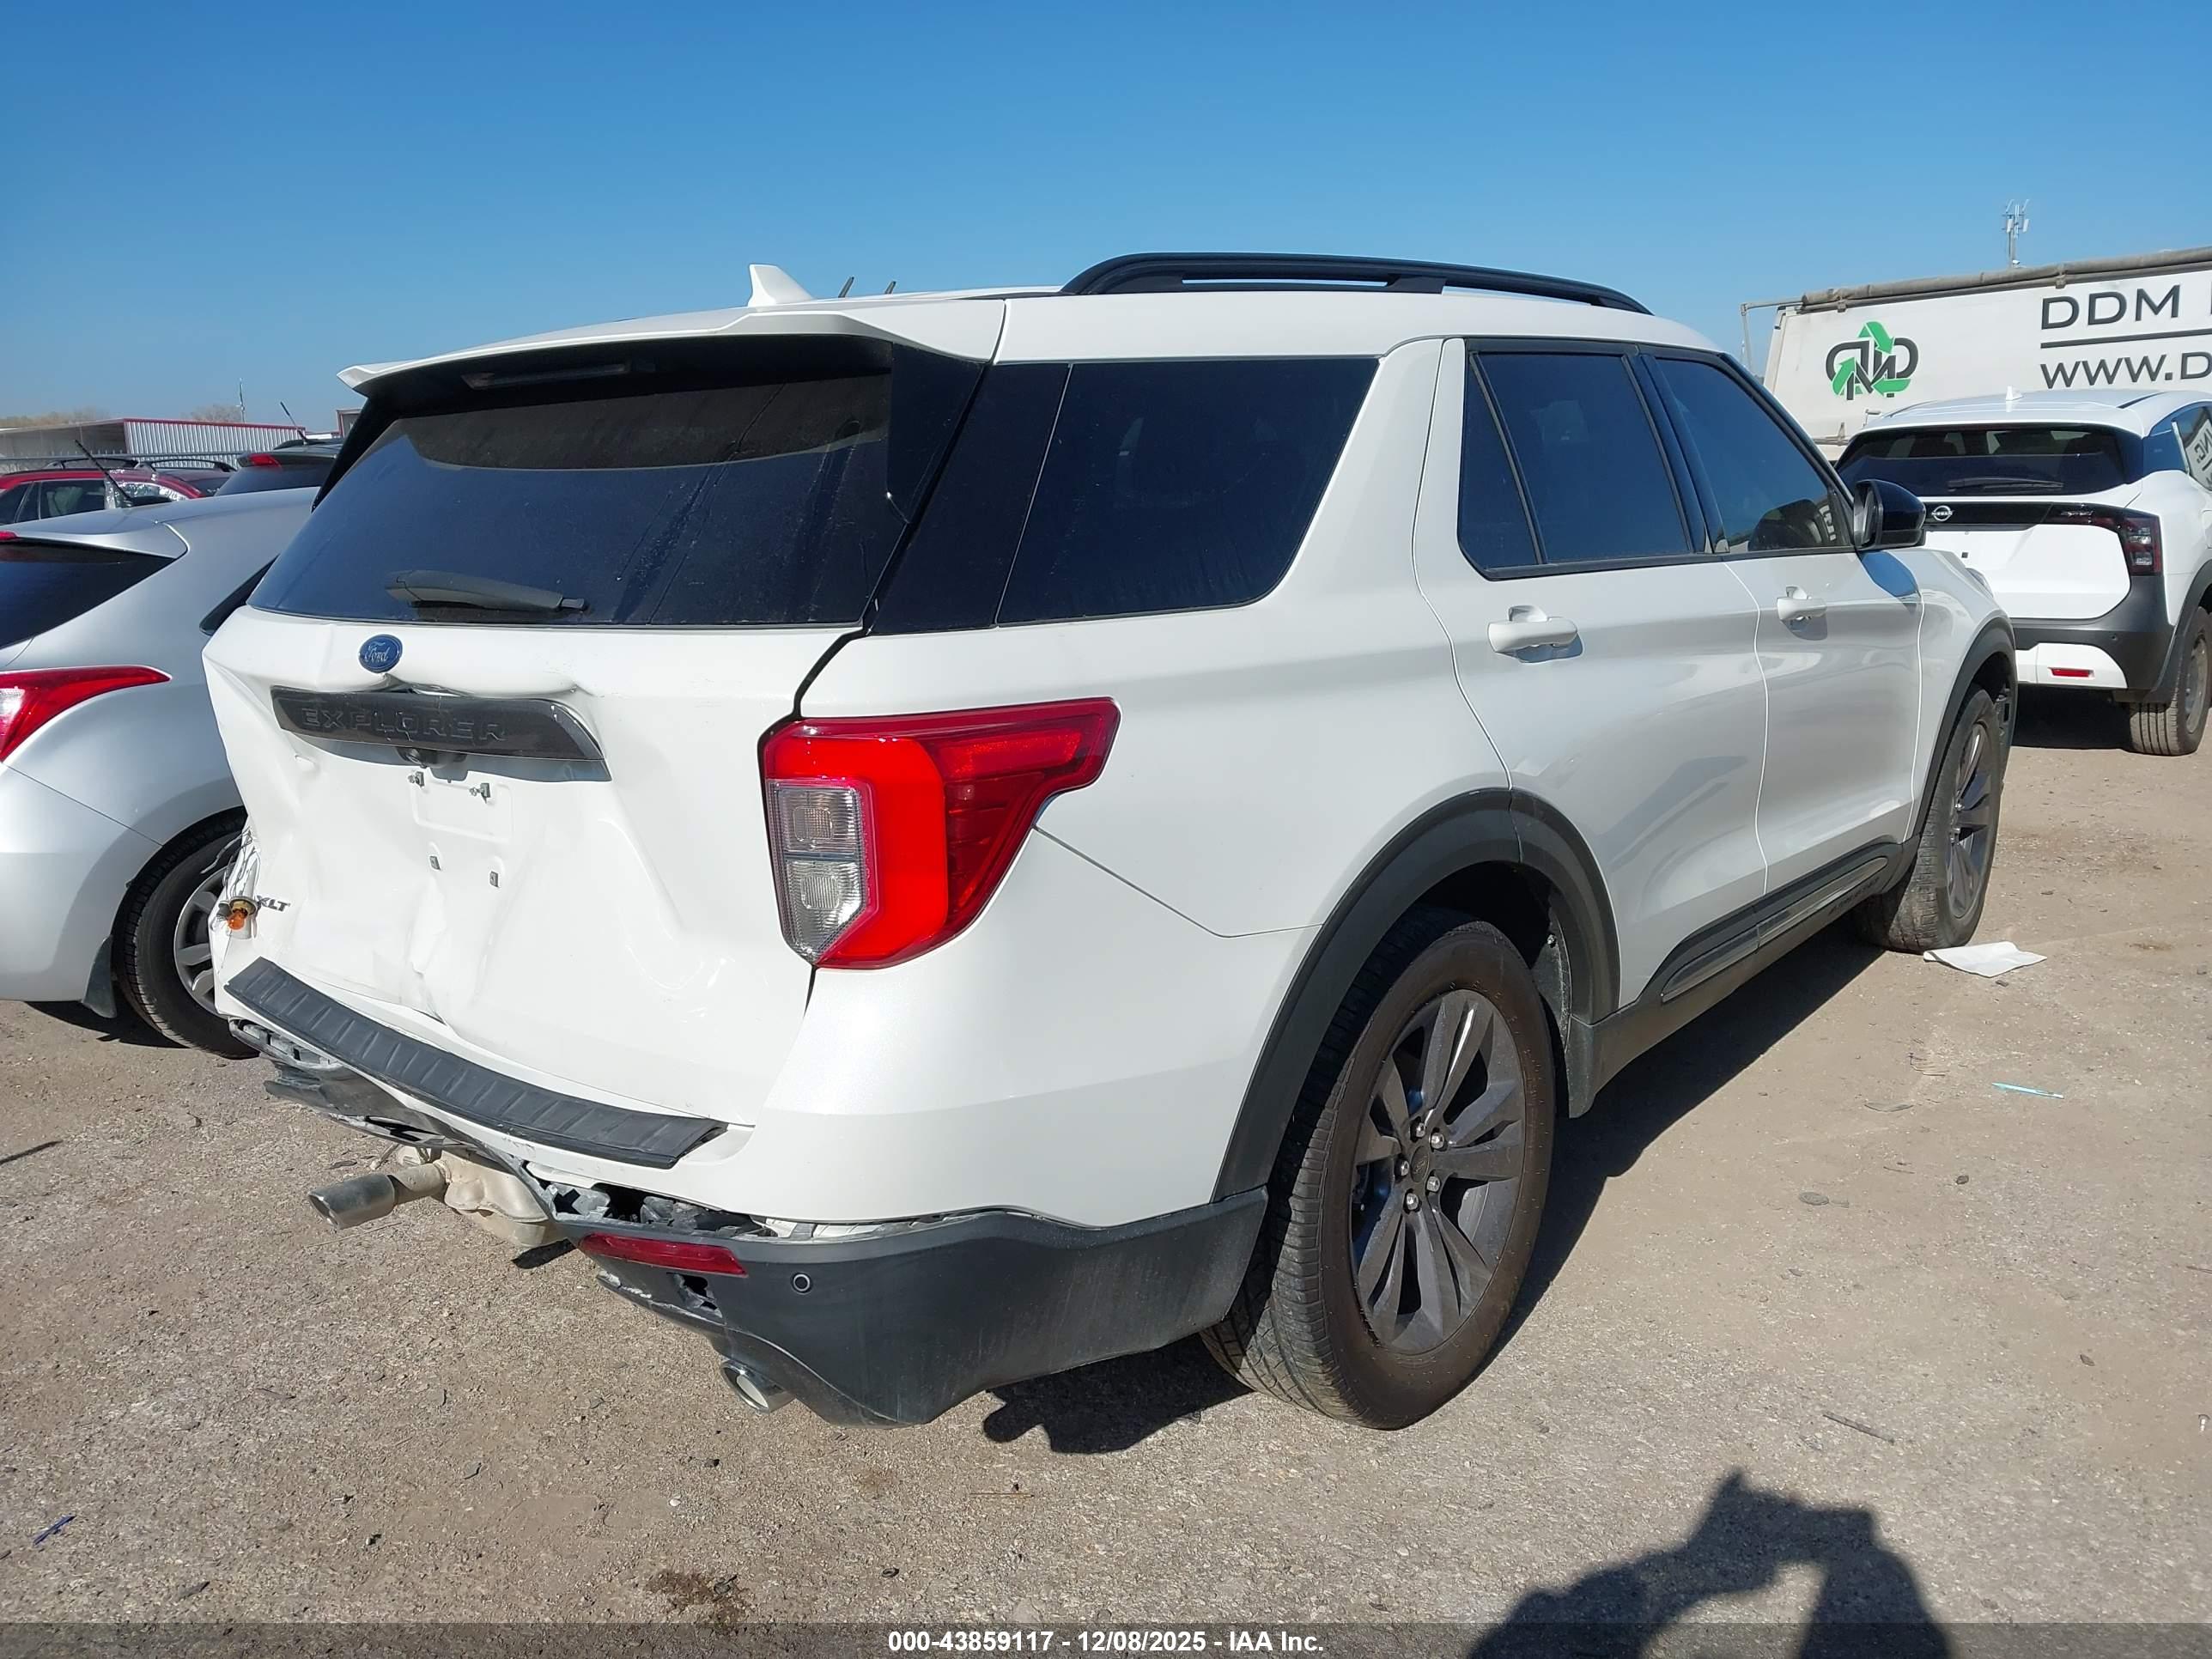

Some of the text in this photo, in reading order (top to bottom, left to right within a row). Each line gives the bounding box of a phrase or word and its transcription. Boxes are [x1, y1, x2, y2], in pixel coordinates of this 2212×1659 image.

[2041, 284, 2181, 330] DDM
[301, 708, 507, 742] EXPLORER
[257, 895, 291, 912] XLT
